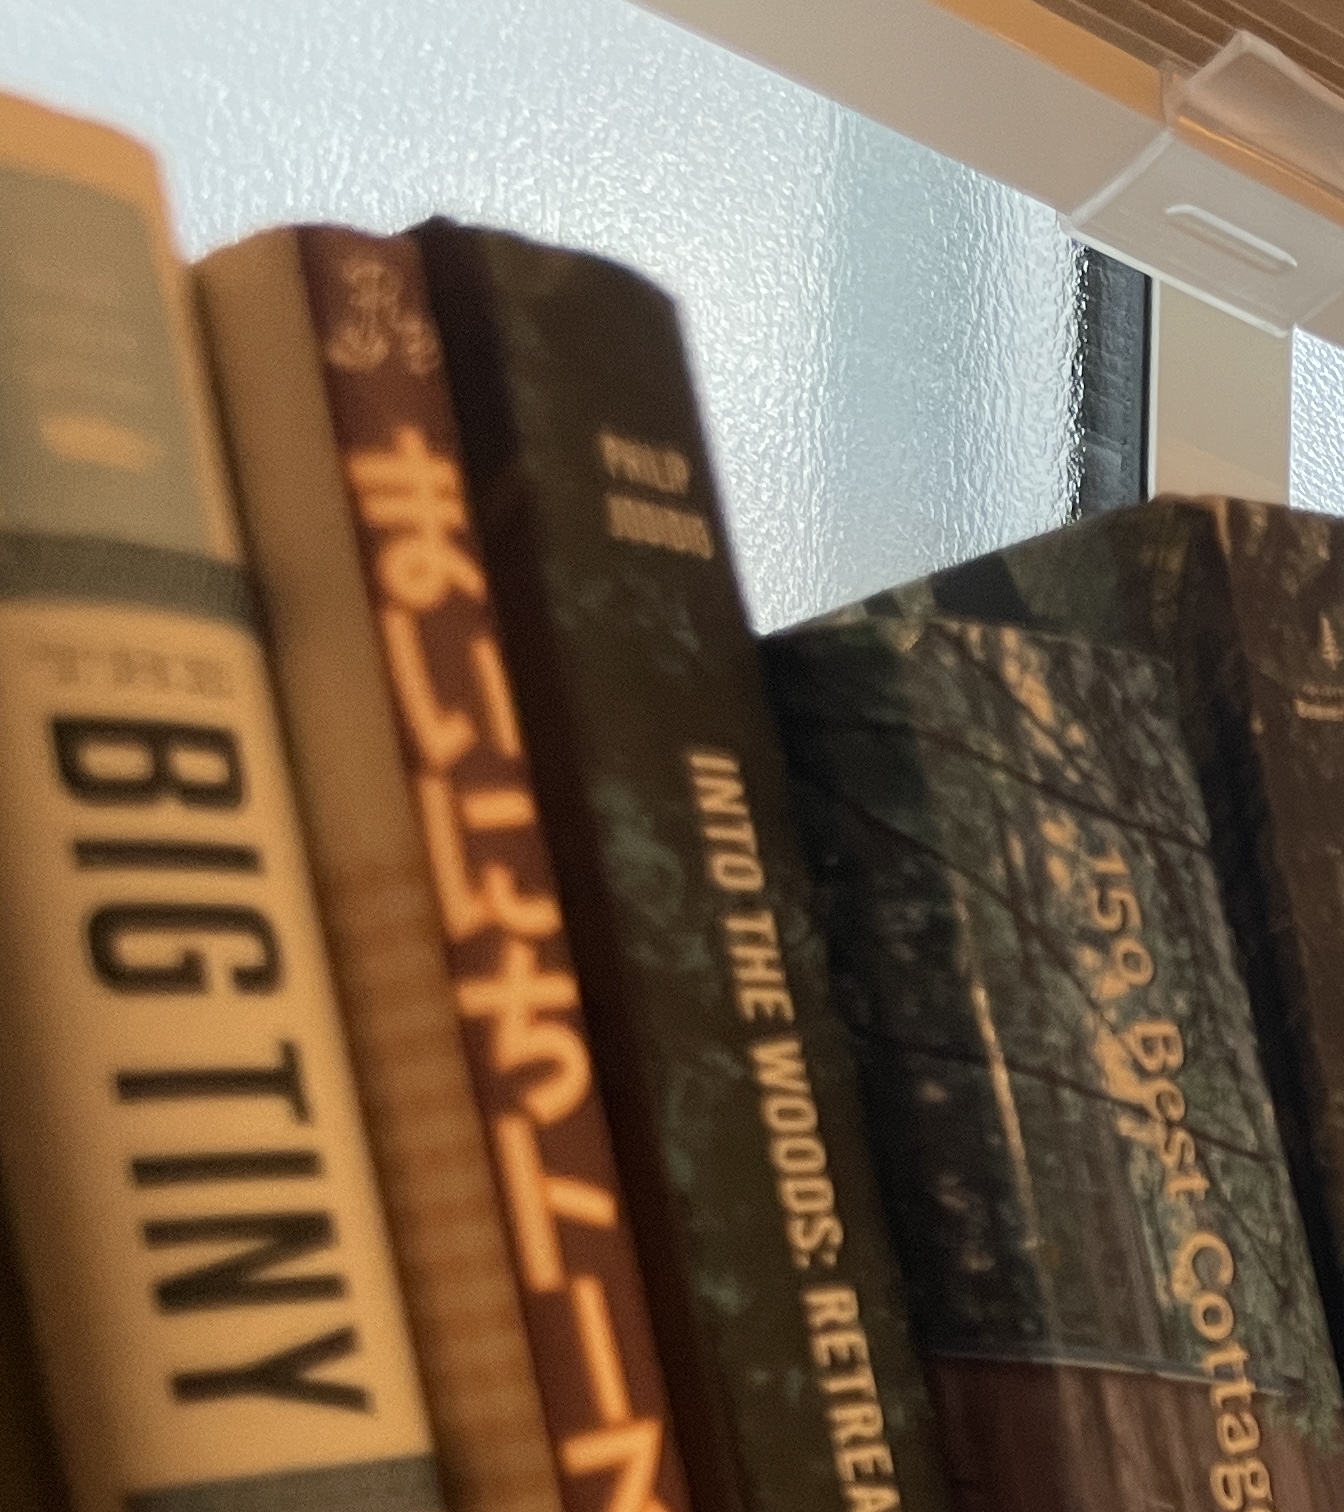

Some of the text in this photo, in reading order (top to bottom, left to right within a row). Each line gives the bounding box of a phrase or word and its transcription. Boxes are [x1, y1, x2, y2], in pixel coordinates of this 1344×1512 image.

[50, 712, 284, 1000] BIG
[690, 752, 765, 892] INTO
[724, 908, 795, 1021] THE
[1090, 845, 1155, 990] 150
[752, 1038, 844, 1268] WOODS:
[1120, 1018, 1211, 1202] Best
[112, 1037, 378, 1417] TINY
